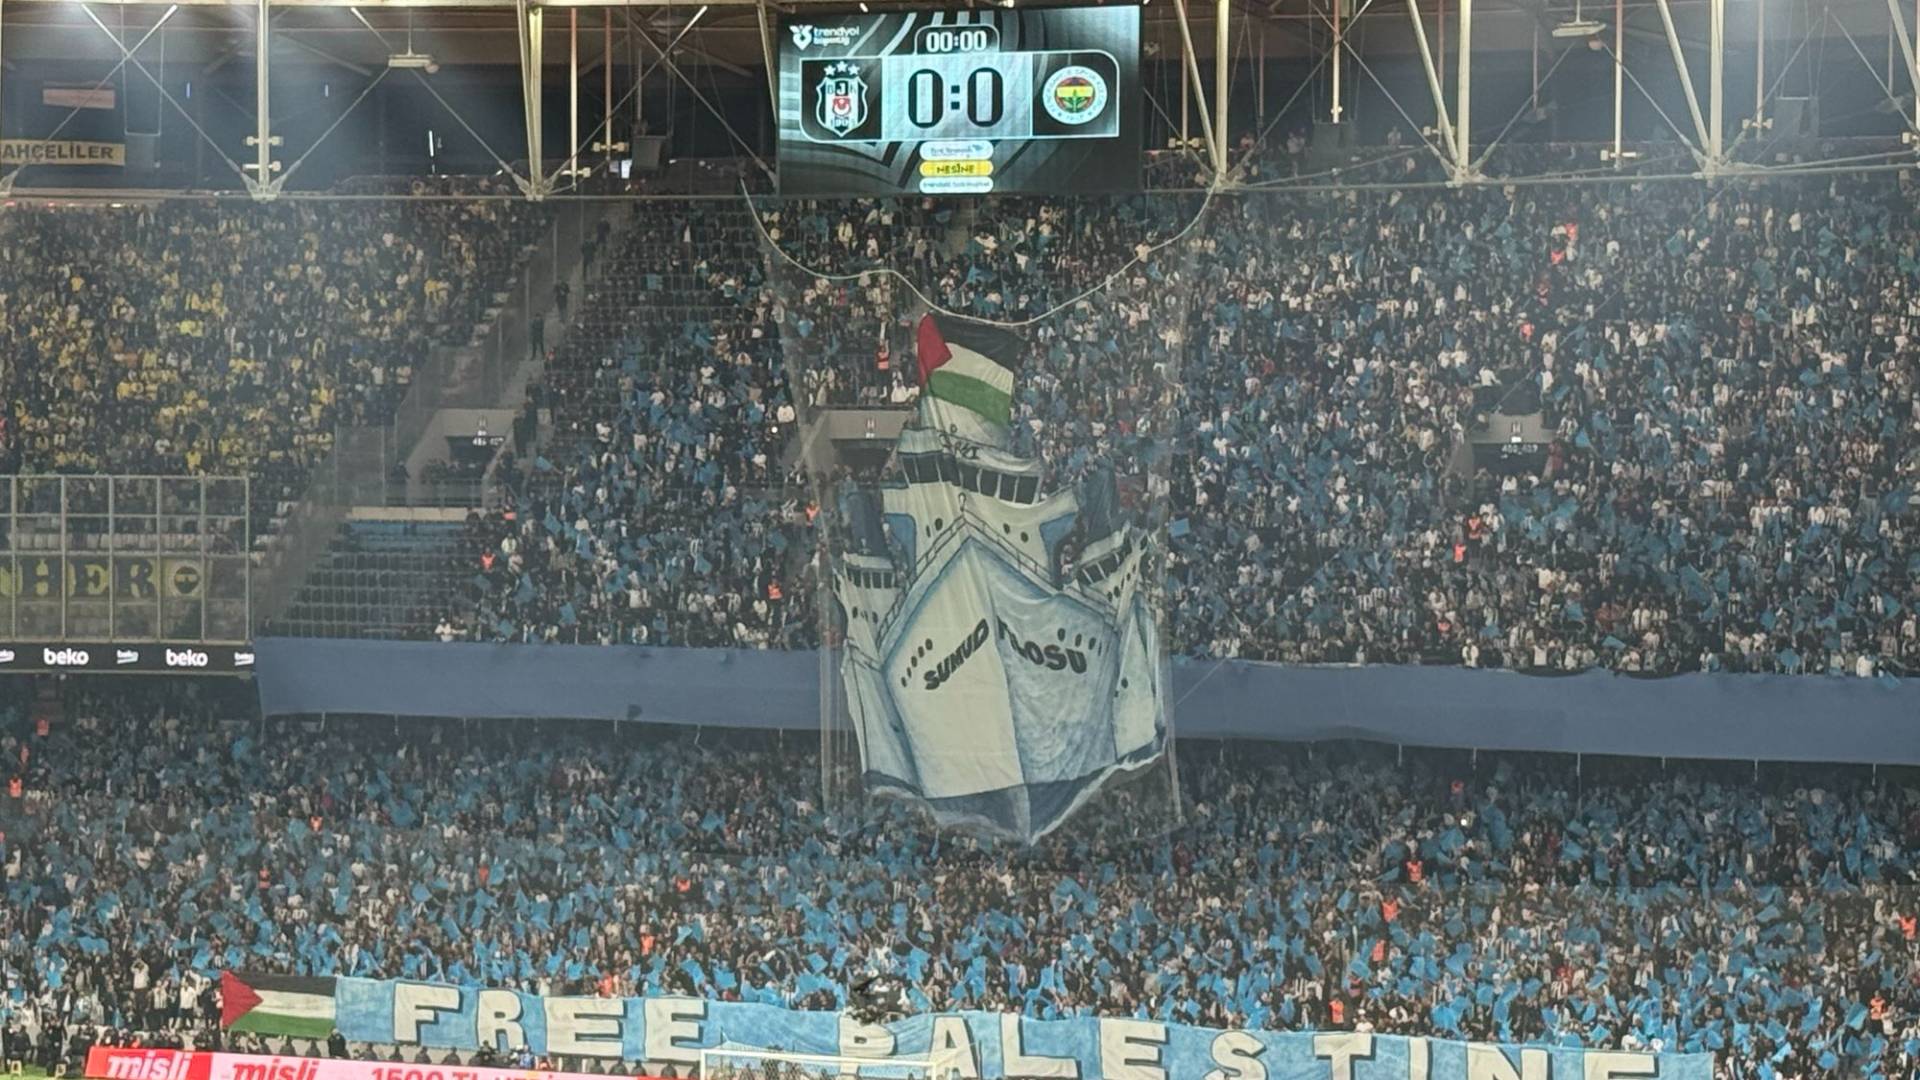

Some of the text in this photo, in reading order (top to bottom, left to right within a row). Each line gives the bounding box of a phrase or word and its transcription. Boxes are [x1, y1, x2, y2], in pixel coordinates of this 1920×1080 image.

[926, 30, 987, 52] 00:00
[908, 67, 1004, 129] 0:0
[0, 143, 114, 160] AHÇELİLER
[43, 648, 89, 665] beko
[165, 648, 209, 667] beko
[924, 618, 990, 690] SUMUD
[393, 983, 707, 1059] FREE
[106, 1050, 194, 1079] misli
[233, 1057, 320, 1080] misli
